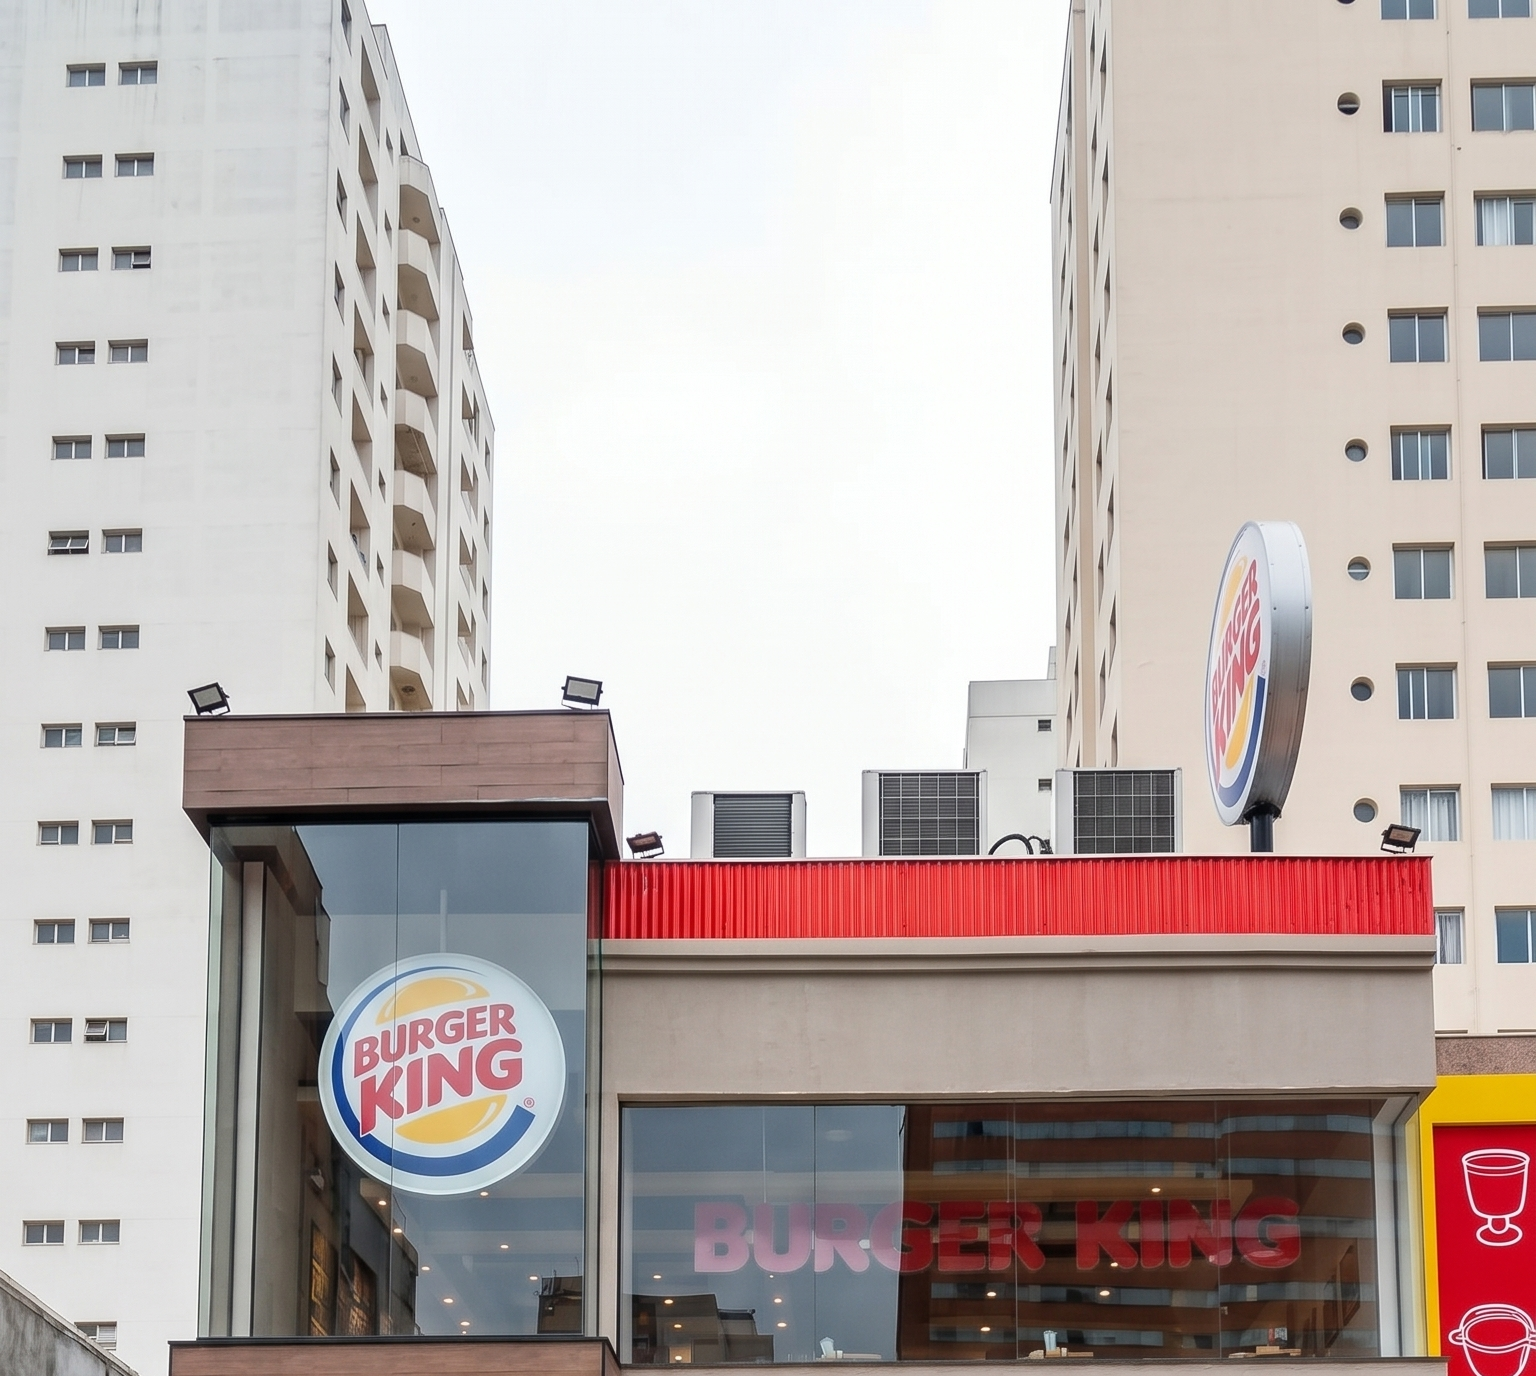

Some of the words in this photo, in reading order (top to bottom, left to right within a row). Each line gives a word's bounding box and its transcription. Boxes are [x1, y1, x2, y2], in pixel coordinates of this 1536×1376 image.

[1211, 558, 1258, 727] BURGER
[1214, 597, 1261, 792] KING
[354, 1003, 516, 1078] BURGER
[360, 1038, 523, 1136] KING
[694, 1200, 1045, 1273] BURGER
[1075, 1197, 1300, 1271] KING
